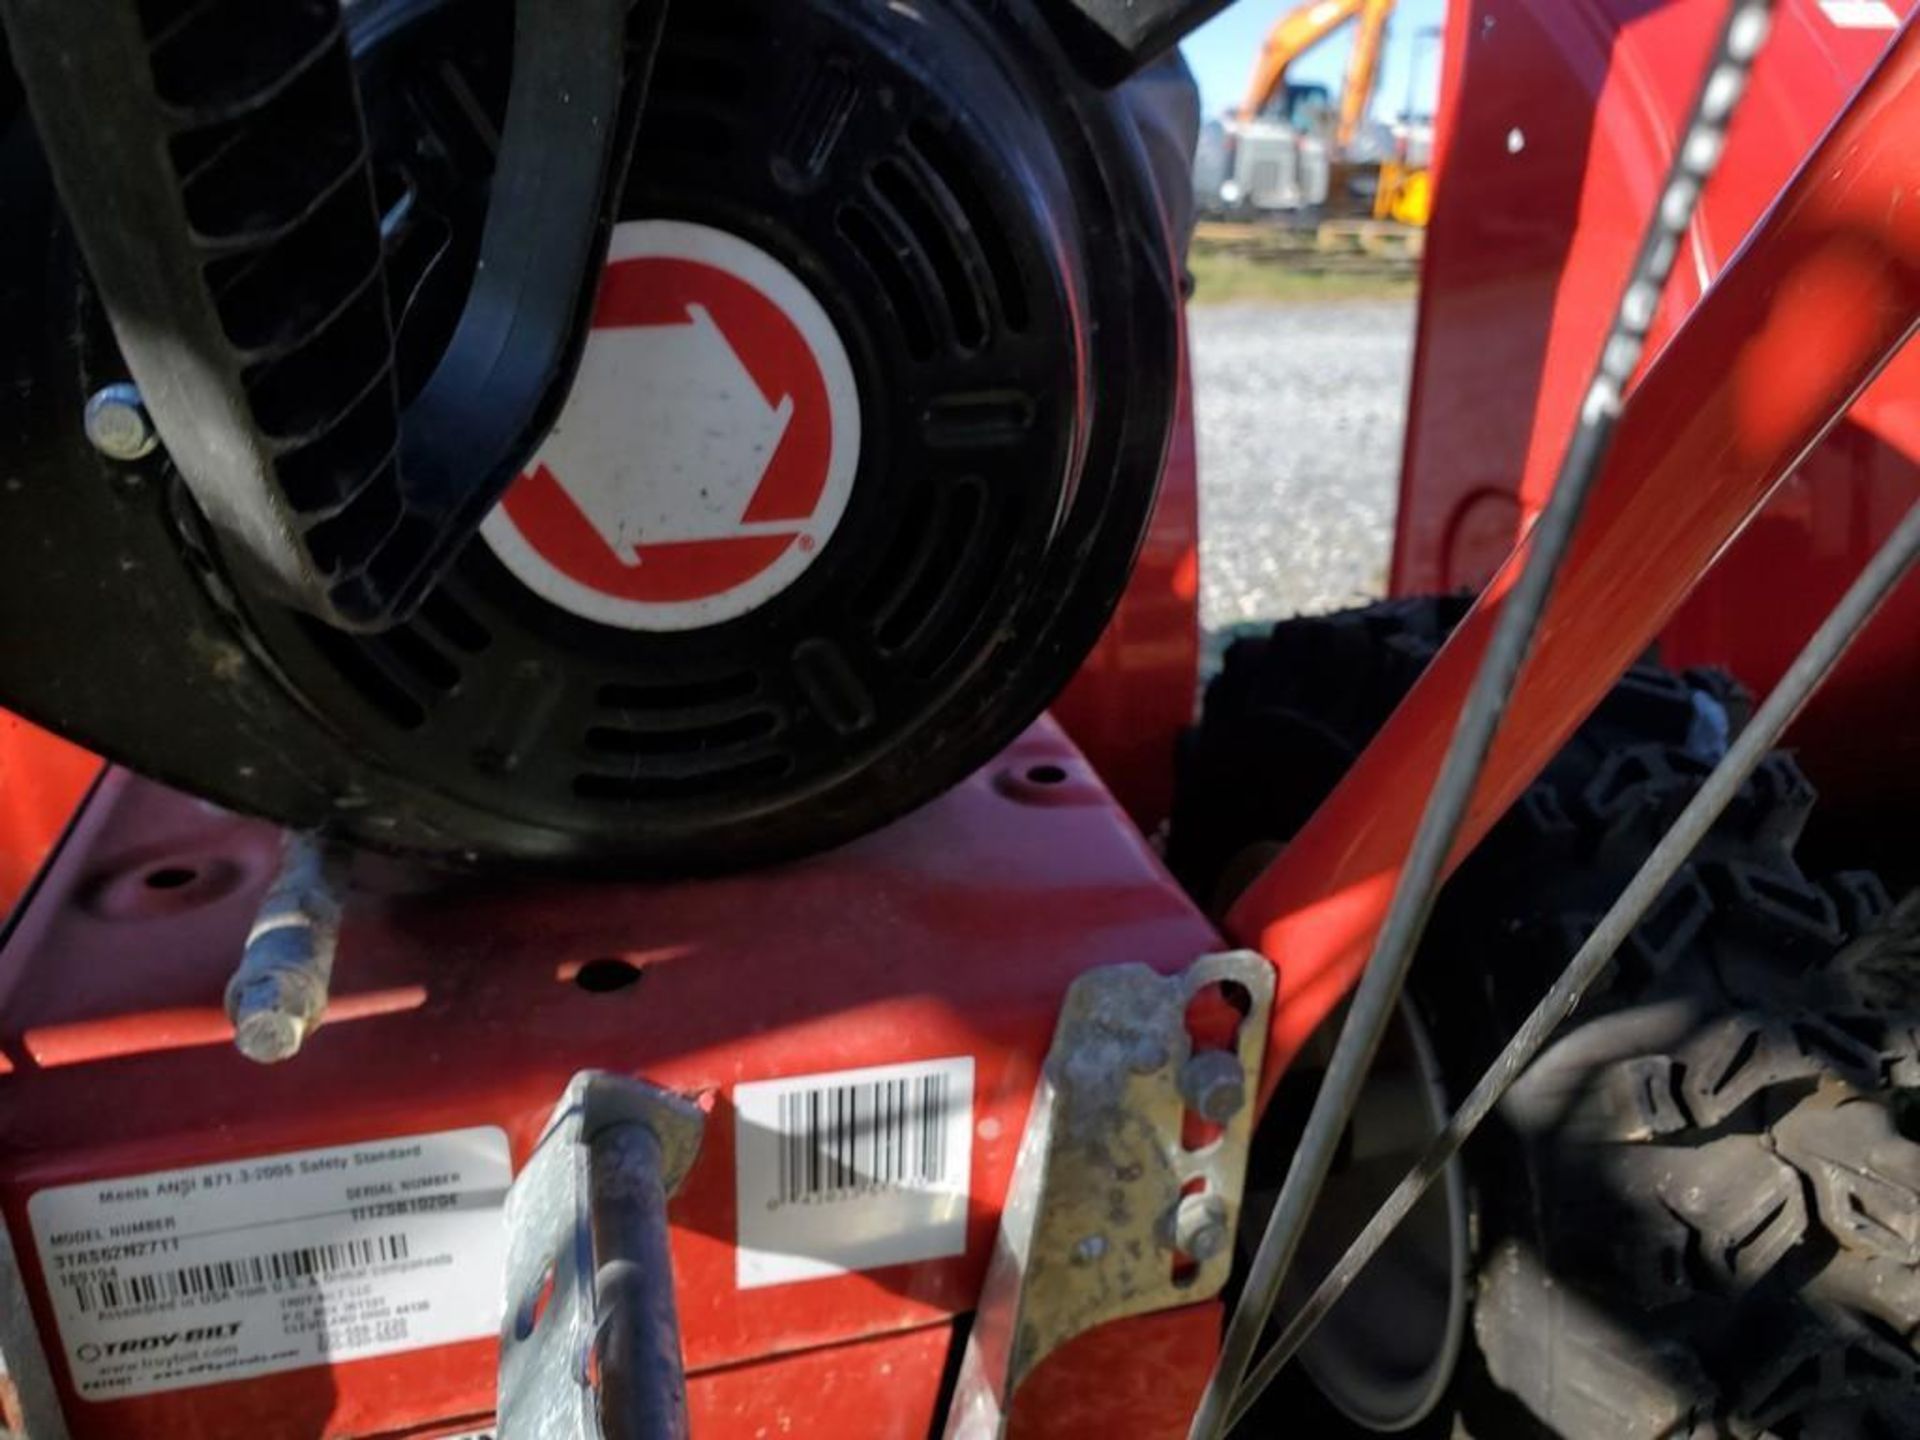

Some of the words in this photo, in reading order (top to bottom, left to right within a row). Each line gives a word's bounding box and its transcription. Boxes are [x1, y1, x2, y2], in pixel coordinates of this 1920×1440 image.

[100, 1187, 149, 1202] Meets
[300, 1157, 347, 1174] Safety
[354, 1145, 421, 1165] Standard
[346, 1182, 394, 1200] SERIAL
[400, 1173, 460, 1191] NUMBER
[50, 1228, 103, 1246] MODEL
[110, 1216, 176, 1237] NUMBER
[104, 1321, 242, 1357] TROY-BILT
